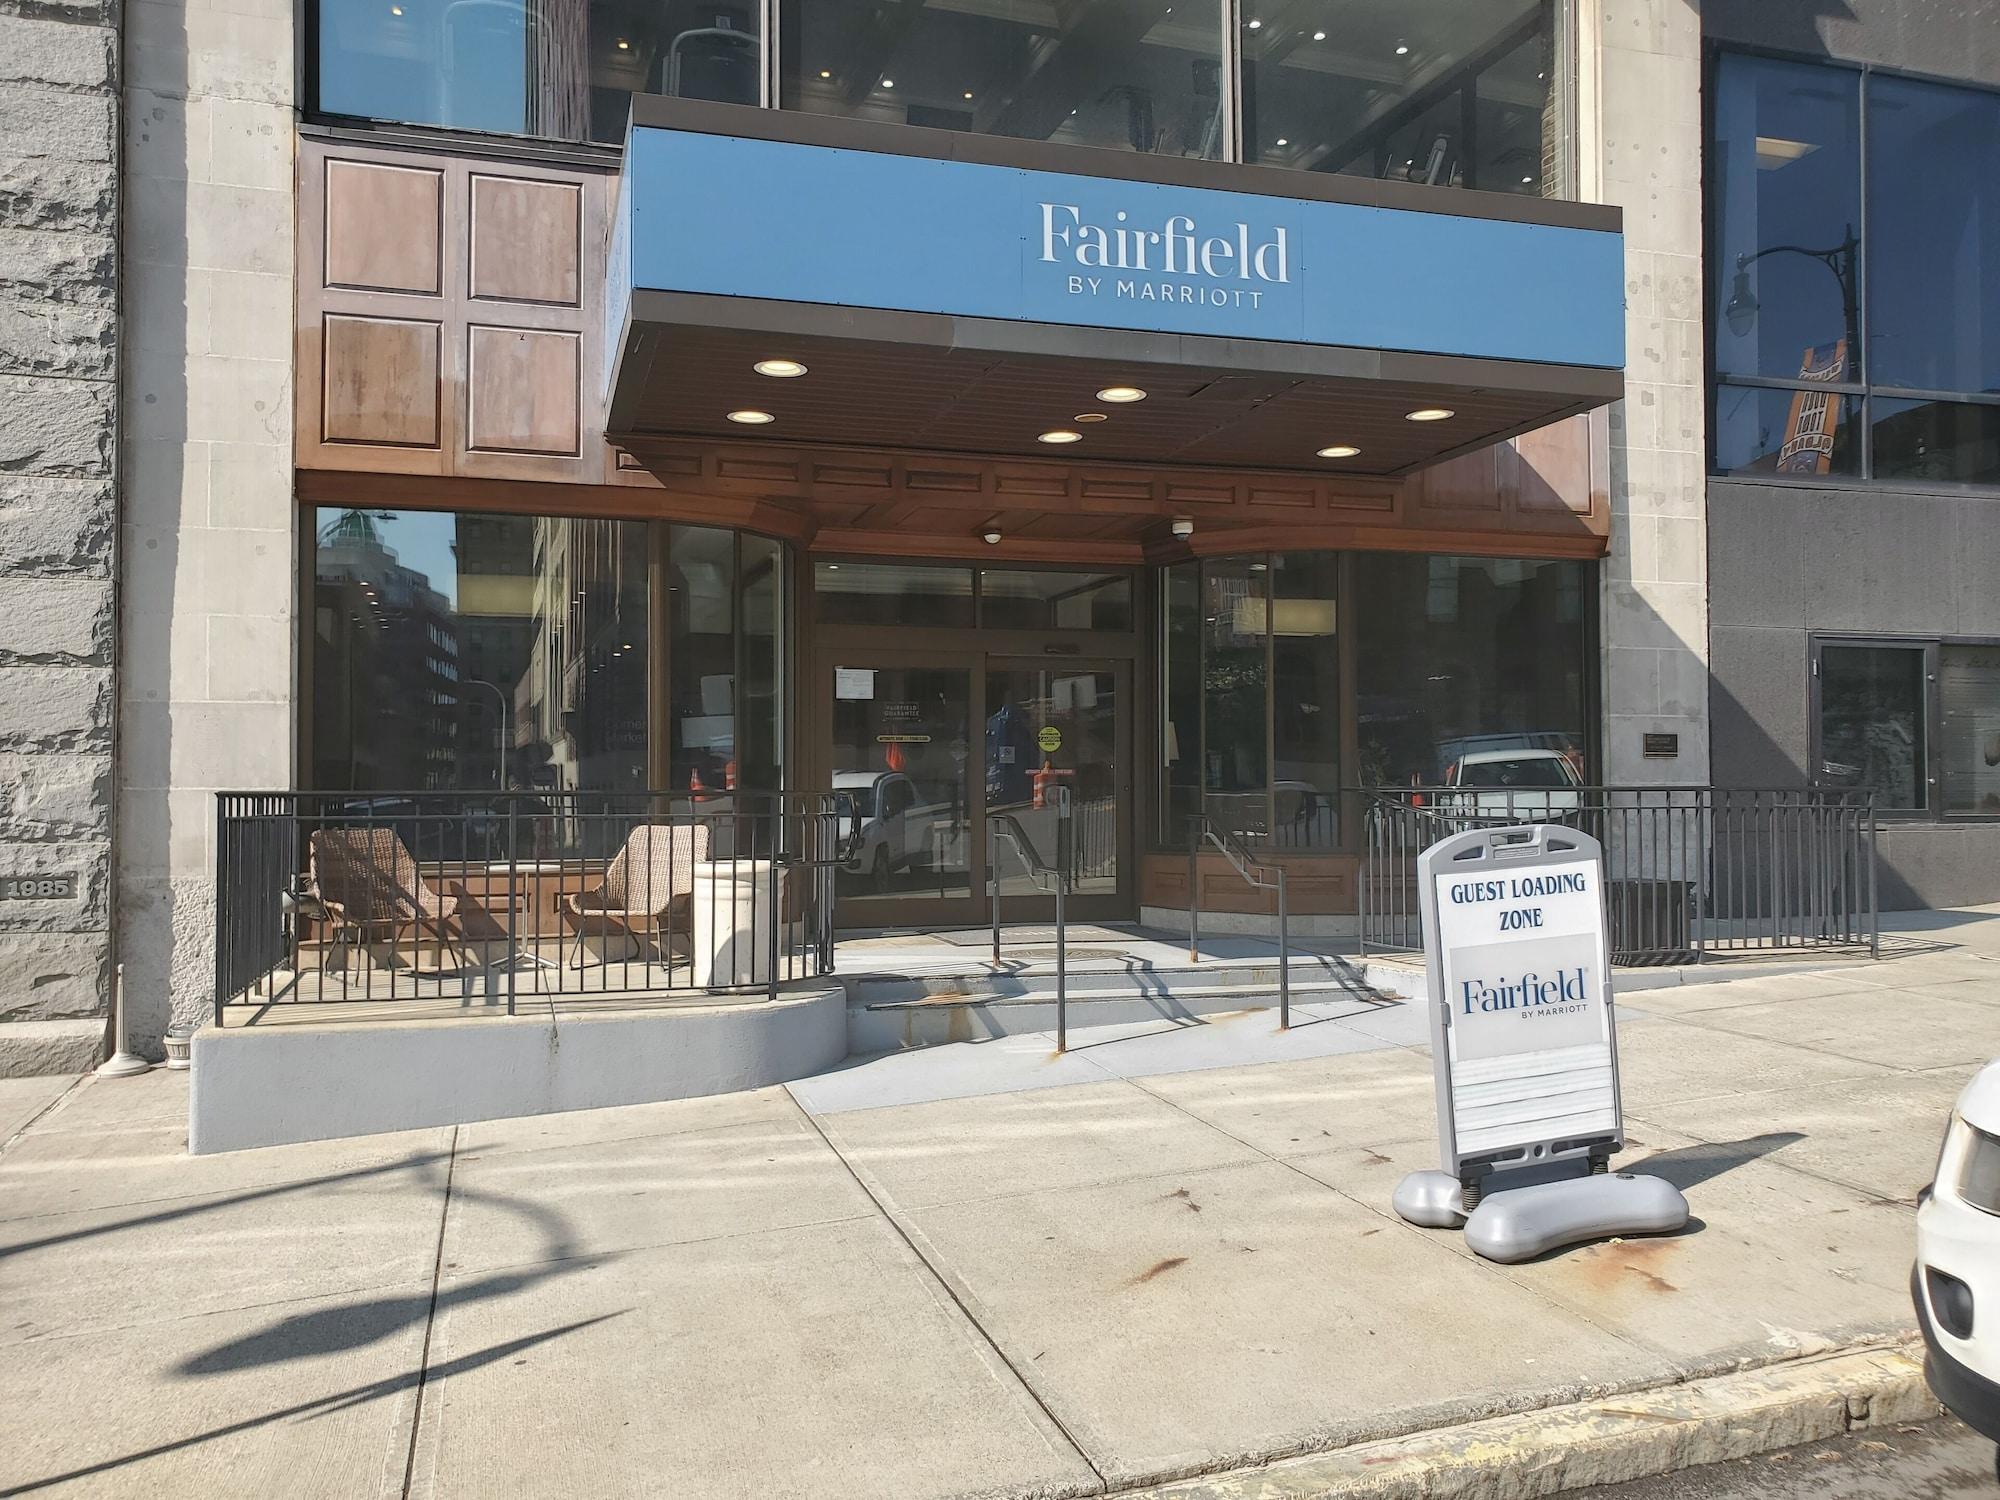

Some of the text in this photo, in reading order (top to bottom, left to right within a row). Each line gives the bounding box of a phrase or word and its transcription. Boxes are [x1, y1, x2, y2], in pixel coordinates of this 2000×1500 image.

[1037, 203, 1291, 284] Fairfield
[1068, 275, 1264, 309] BY MARRIOTT
[7, 880, 69, 897] 1985
[1451, 873, 1586, 904] GUEST LOADING
[1499, 908, 1544, 931] ZONE
[1460, 967, 1588, 1015] Fairfield
[1521, 1004, 1588, 1019] BY MARRIOTT
